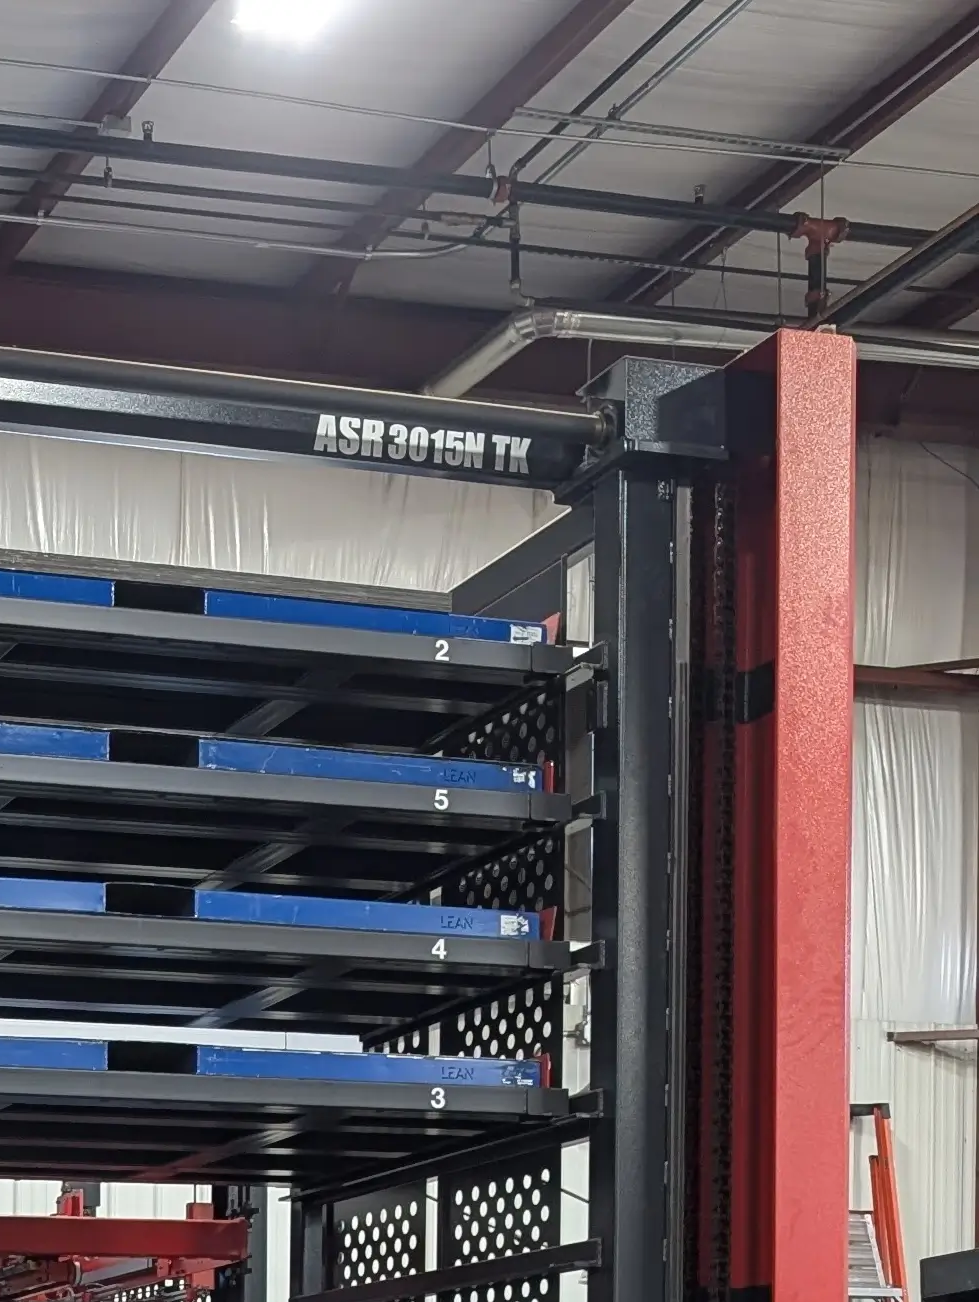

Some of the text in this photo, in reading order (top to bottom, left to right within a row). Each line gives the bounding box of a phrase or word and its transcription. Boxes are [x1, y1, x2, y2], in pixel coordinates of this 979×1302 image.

[491, 433, 532, 475] TK
[434, 639, 450, 661] 2
[443, 768, 477, 784] LEAN
[433, 788, 449, 810] 5
[440, 914, 474, 930] LEAN
[431, 938, 447, 960] 4
[441, 1066, 475, 1080] LEAN
[430, 1086, 446, 1109] 3
